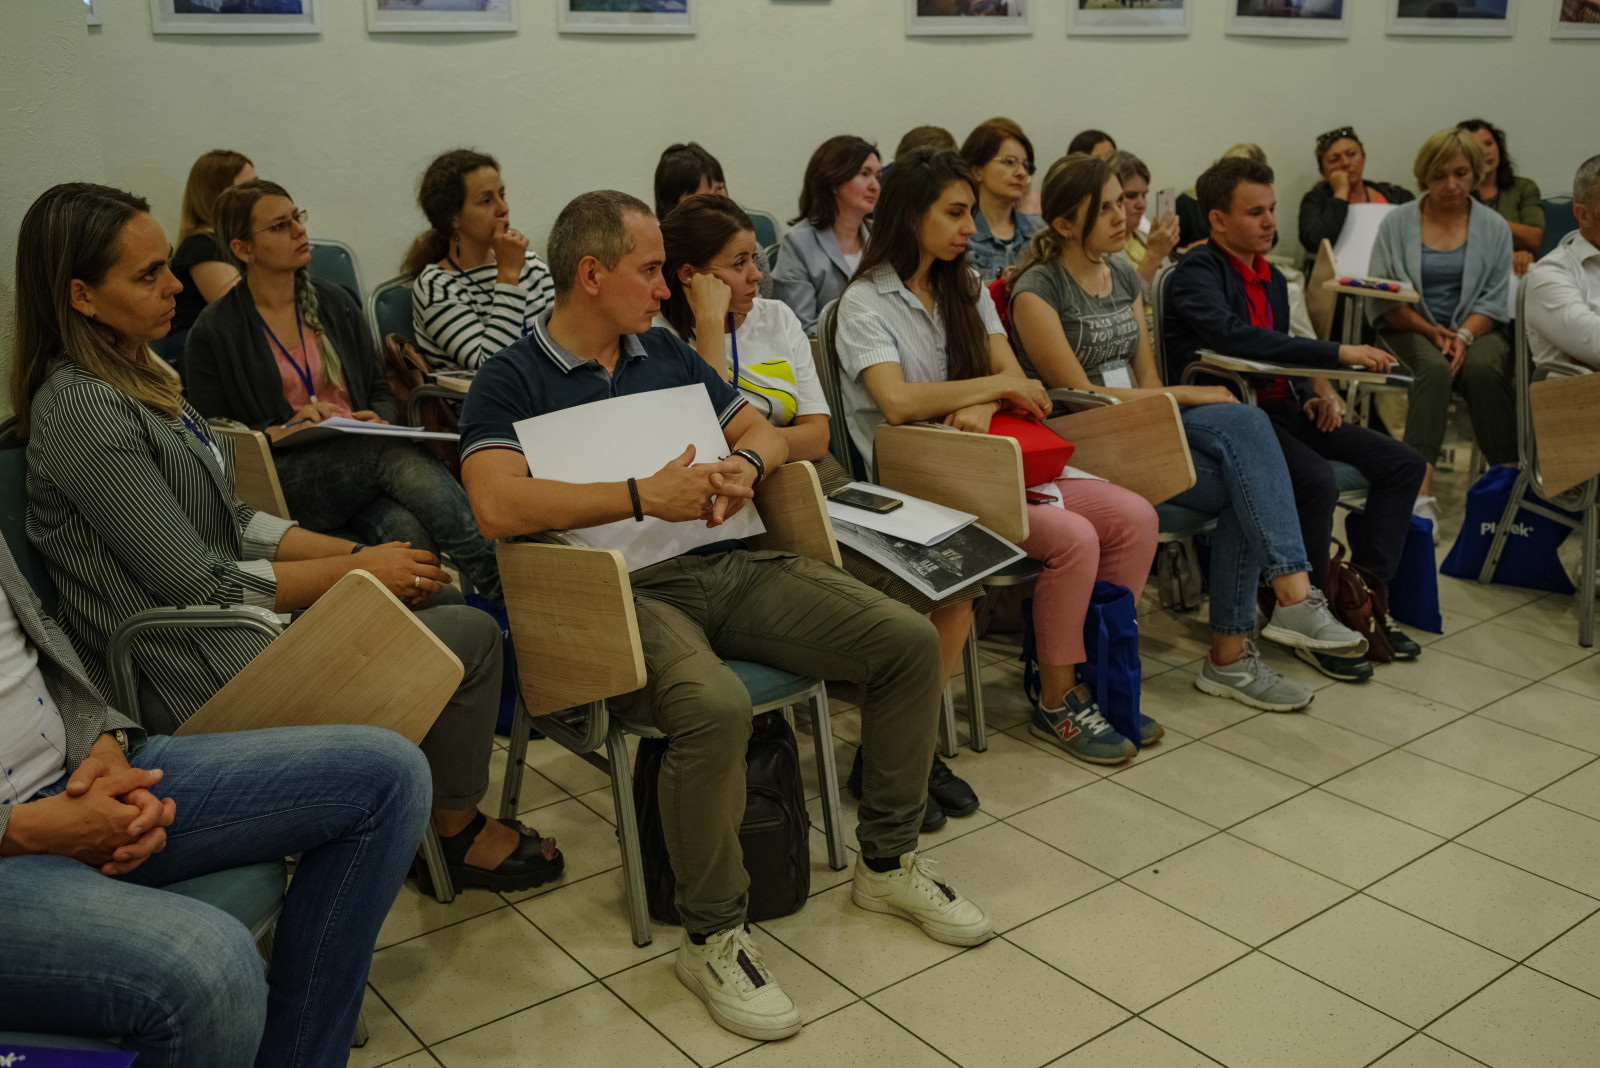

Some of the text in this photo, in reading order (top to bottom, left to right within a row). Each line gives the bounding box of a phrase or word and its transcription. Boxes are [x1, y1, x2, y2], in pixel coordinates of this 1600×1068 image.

[1090, 320, 1138, 343] YOU NEED
[1055, 718, 1082, 742] N
